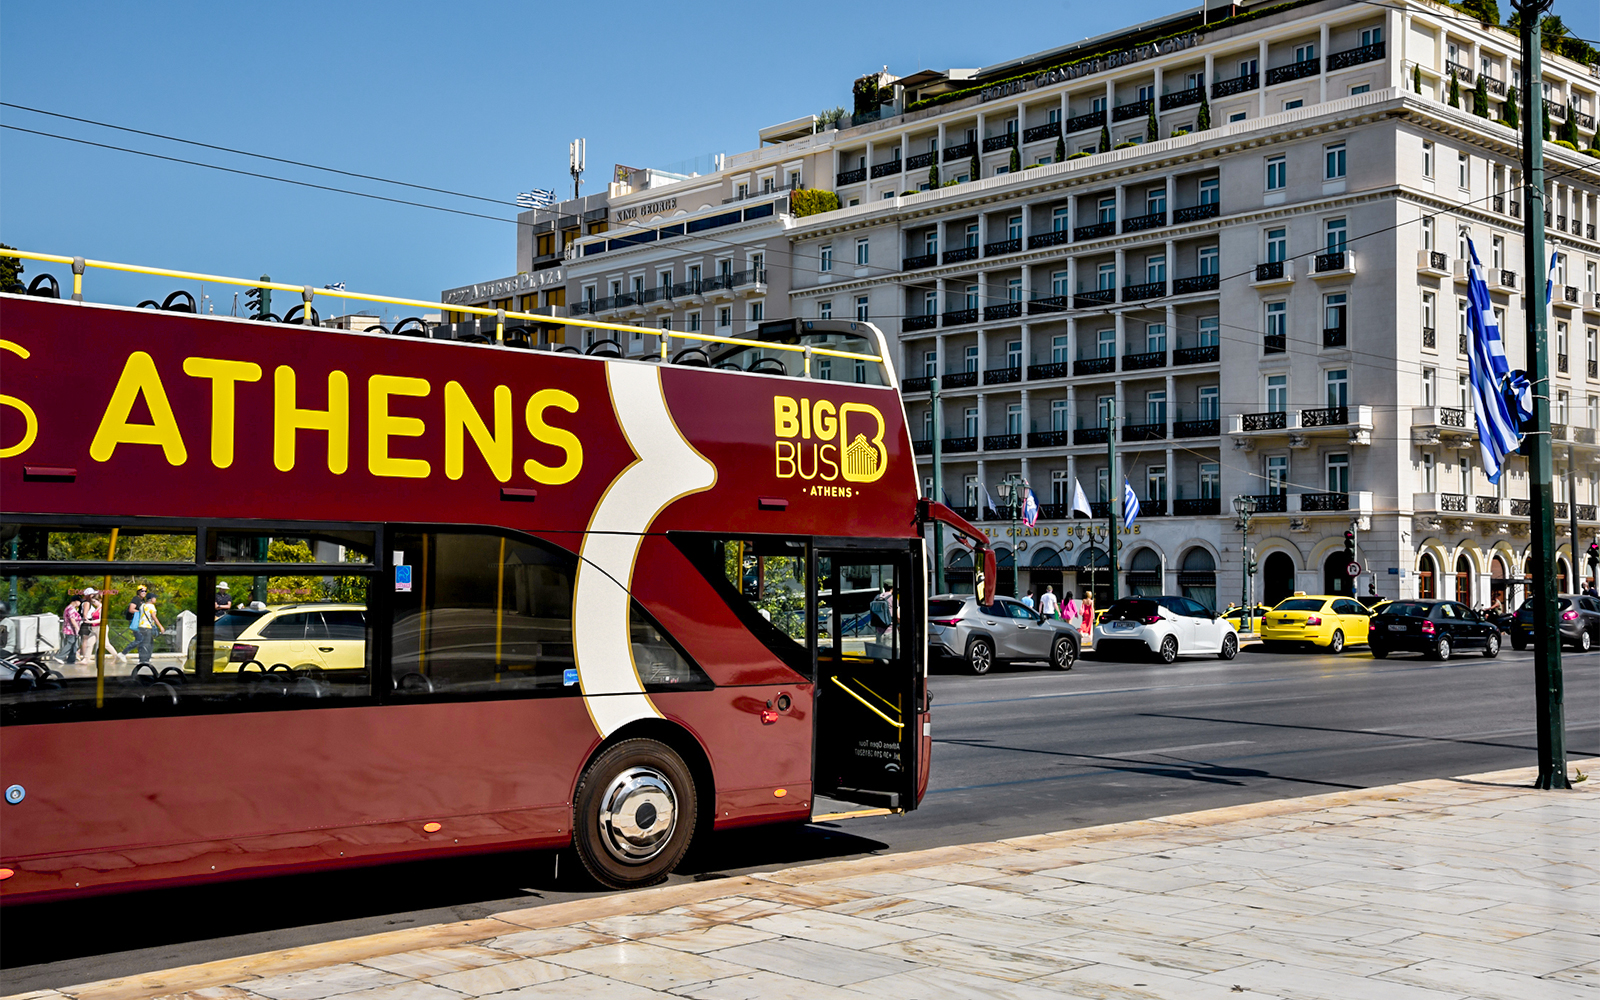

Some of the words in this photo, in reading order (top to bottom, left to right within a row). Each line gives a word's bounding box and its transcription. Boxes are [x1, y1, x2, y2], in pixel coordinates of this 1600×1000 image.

[980, 79, 1026, 102] HOTEL
[1034, 59, 1100, 88] GRANDE
[1108, 32, 1197, 68] BRETAGNE
[616, 207, 637, 222] KING
[640, 198, 677, 216] GEORGE
[471, 278, 518, 300] ATHENS
[521, 269, 562, 290] PLAZA
[90, 351, 584, 485] ATHENS
[774, 396, 838, 441] BIG
[776, 441, 839, 481] BUS
[810, 485, 852, 497] ATHENS
[1005, 527, 1059, 537] GRANDE
[1067, 525, 1141, 536] BETGNE
